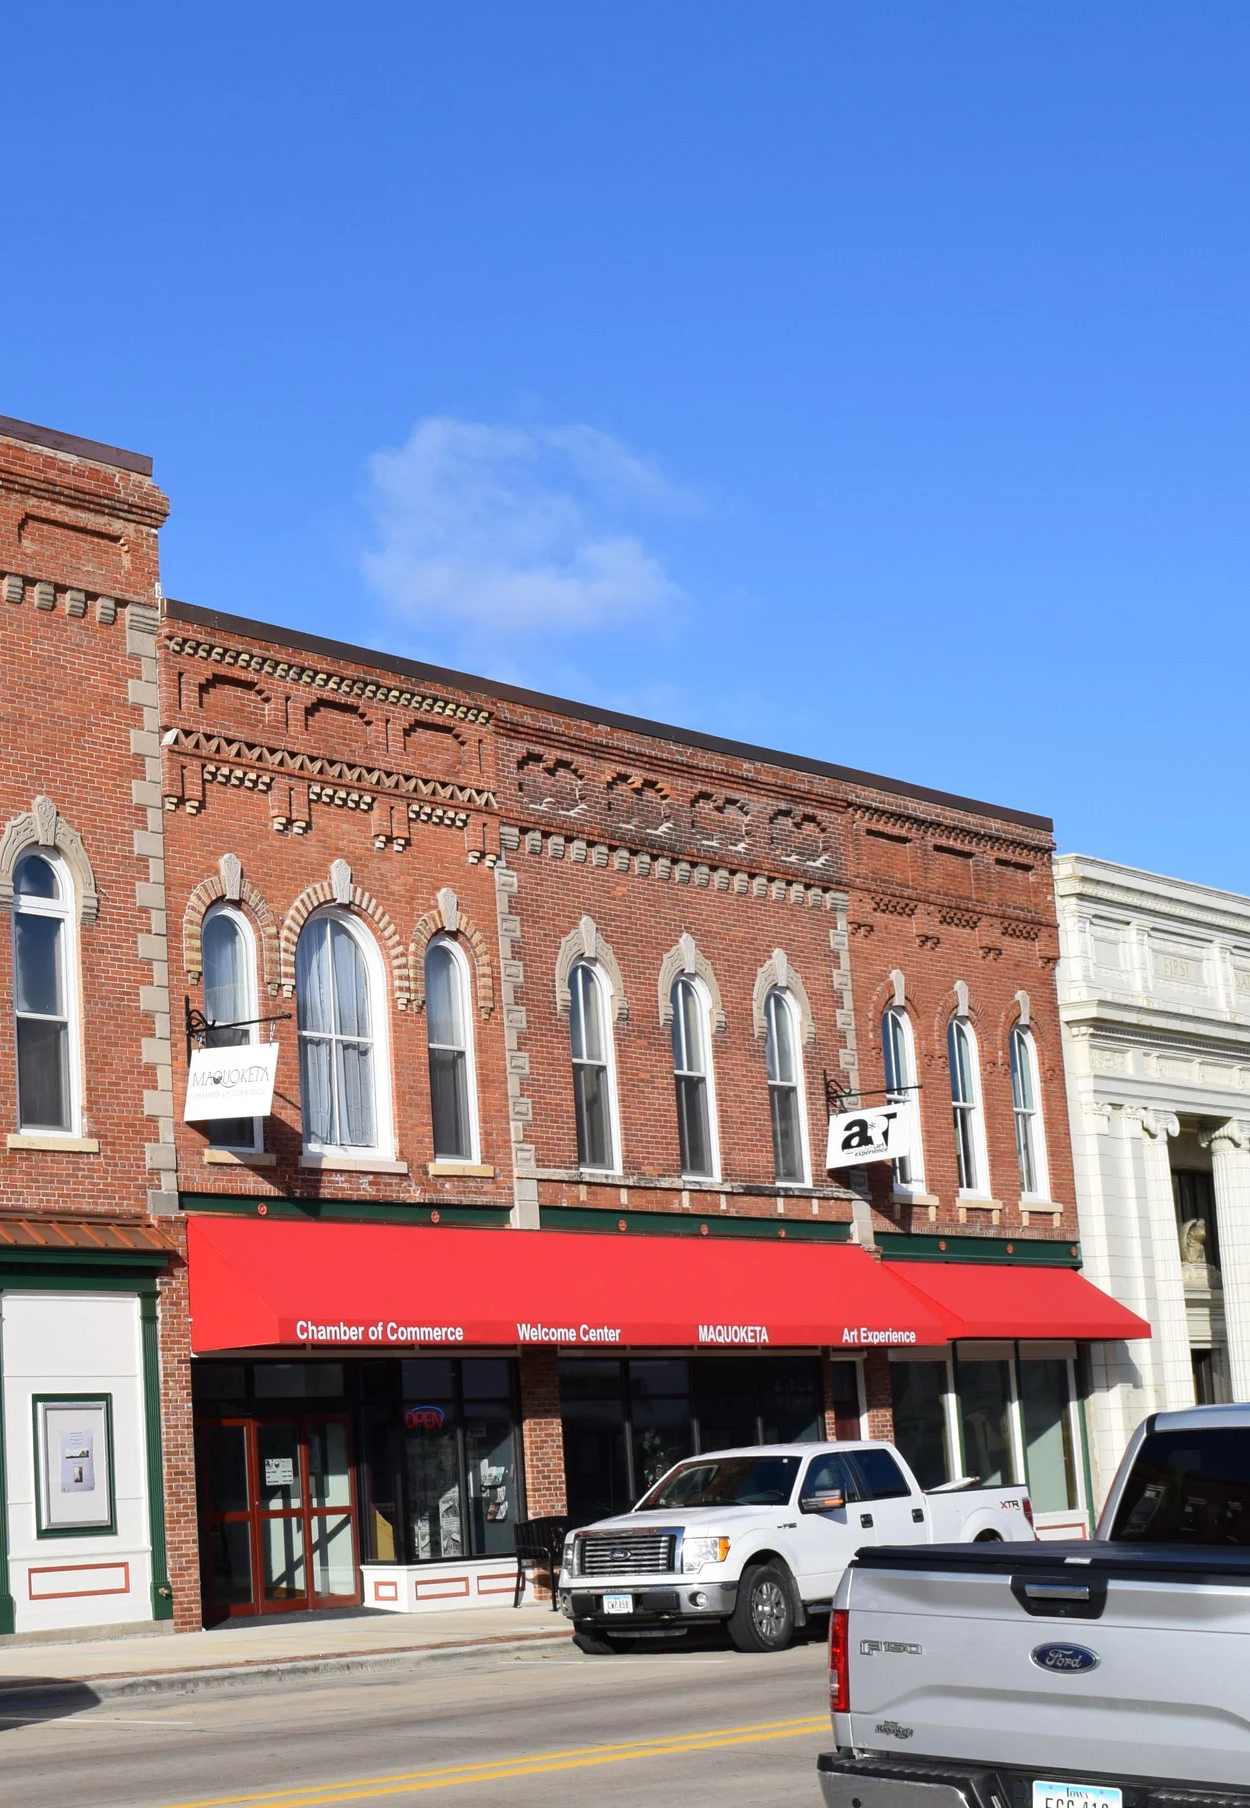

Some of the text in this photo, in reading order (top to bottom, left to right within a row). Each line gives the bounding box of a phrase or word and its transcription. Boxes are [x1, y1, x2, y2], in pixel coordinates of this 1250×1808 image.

[192, 1066, 270, 1088] MAQUOKETA
[296, 1319, 916, 1344] Chamber of Commerce Welcome Center MAQUOKETA Art Experience
[405, 1411, 443, 1429] OPEN
[1000, 1499, 1020, 1509] XTR
[1046, 1649, 1083, 1668] Ford
